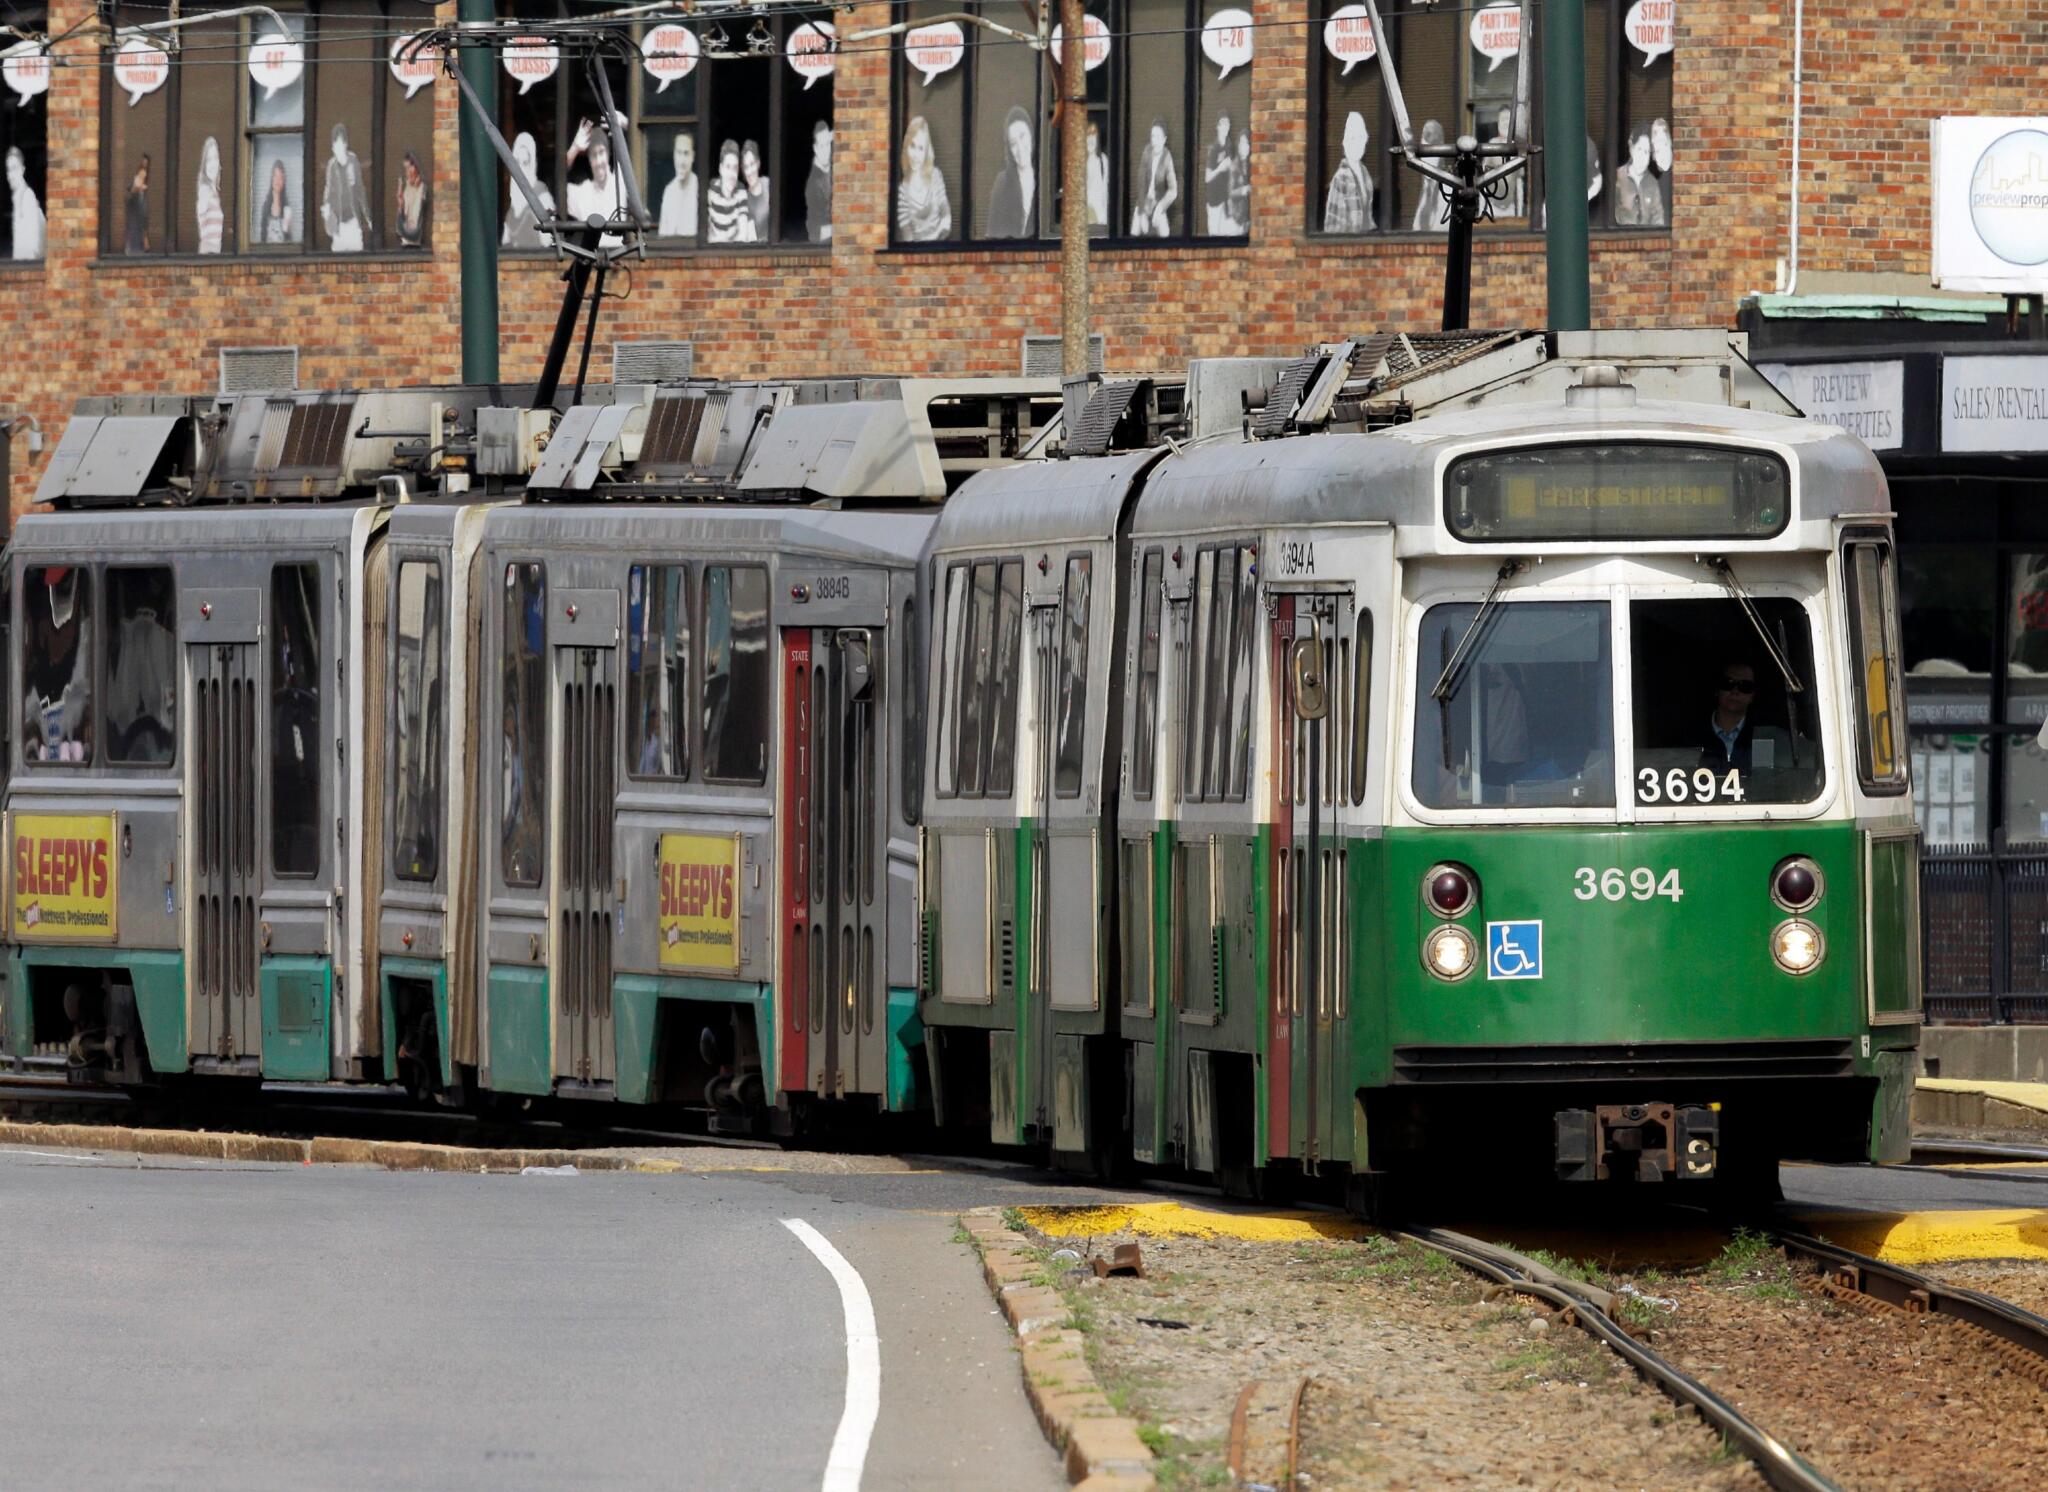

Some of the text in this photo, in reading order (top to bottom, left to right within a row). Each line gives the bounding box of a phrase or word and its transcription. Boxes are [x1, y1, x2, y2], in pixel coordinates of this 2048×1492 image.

[1480, 13, 1500, 29] PART
[1641, 2, 1672, 21] START
[1218, 27, 1244, 48] I-20
[1635, 25, 1664, 44] TODAY
[1336, 36, 1374, 53] COURSES
[1813, 374, 1872, 403] PREVIEW
[1542, 486, 1711, 505] PARK STREET
[817, 576, 850, 600] 3884B
[1274, 620, 1294, 636] STATE
[791, 650, 809, 662] STATE
[1638, 767, 1745, 803] 3694
[1573, 866, 1684, 903] 3694
[792, 907, 806, 919] LAW
[1275, 1024, 1290, 1039] LAW
